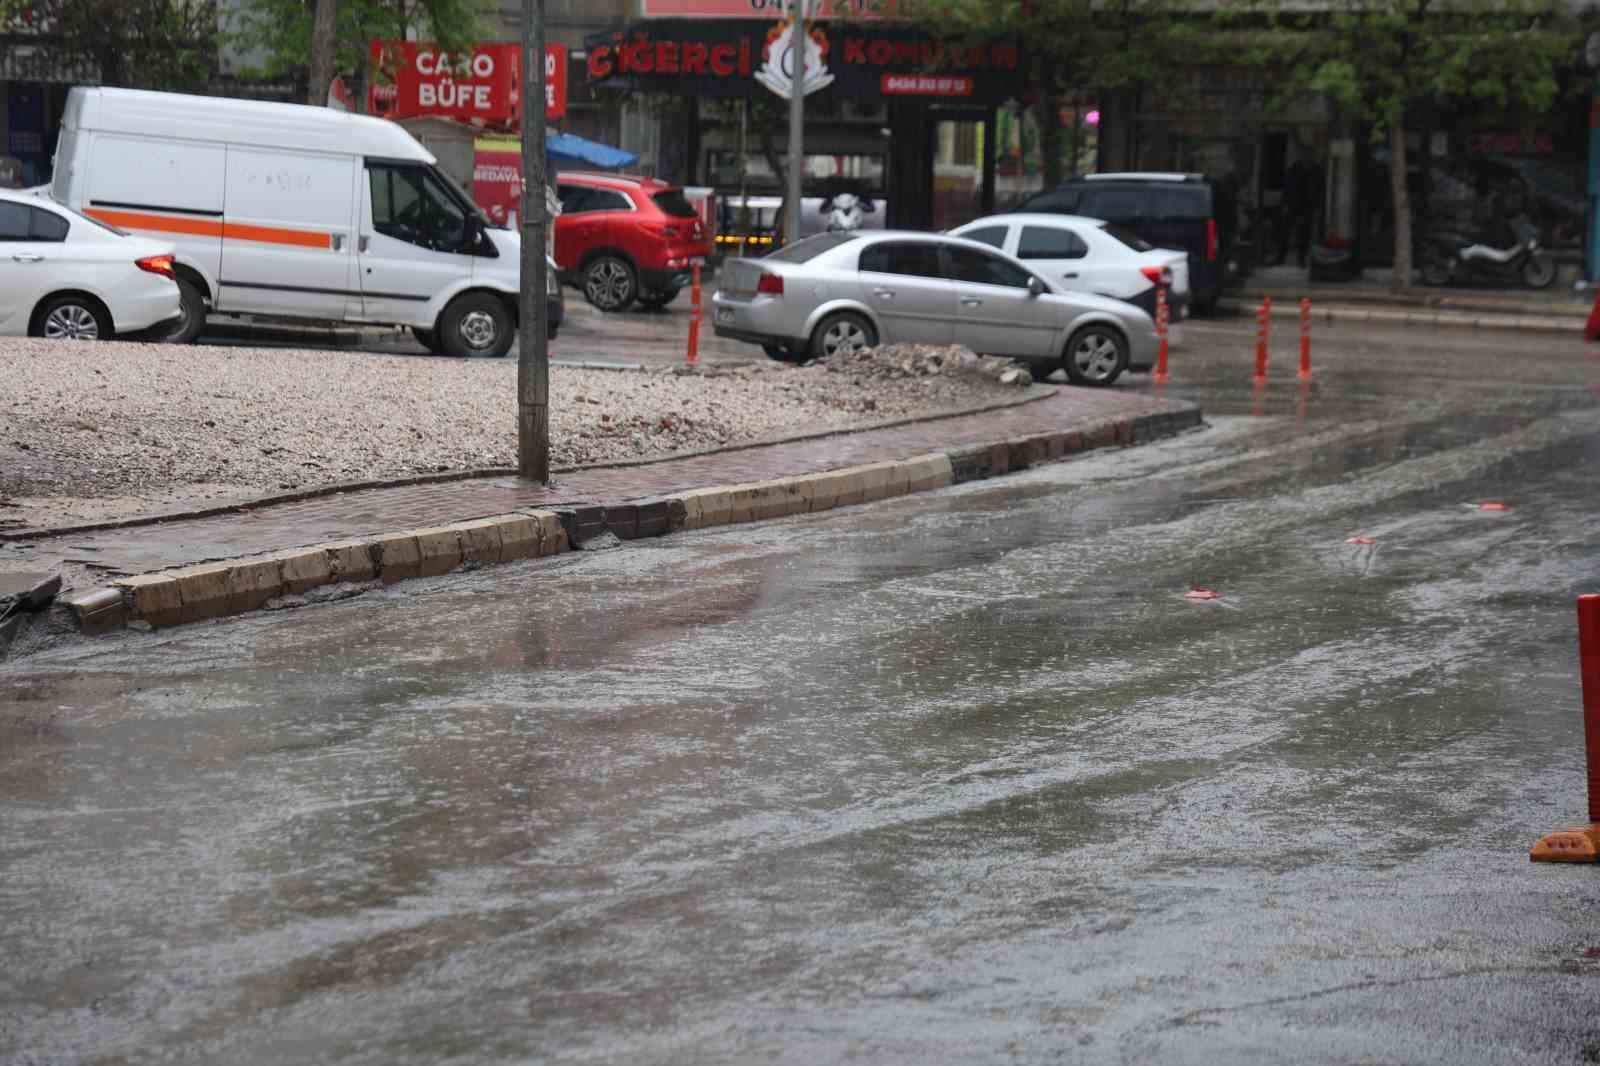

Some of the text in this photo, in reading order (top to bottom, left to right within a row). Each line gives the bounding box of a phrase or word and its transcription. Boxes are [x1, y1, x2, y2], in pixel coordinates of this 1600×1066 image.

[416, 52, 494, 77] CARO
[419, 79, 492, 109] BÜFE
[474, 168, 520, 183] BEDAVA
